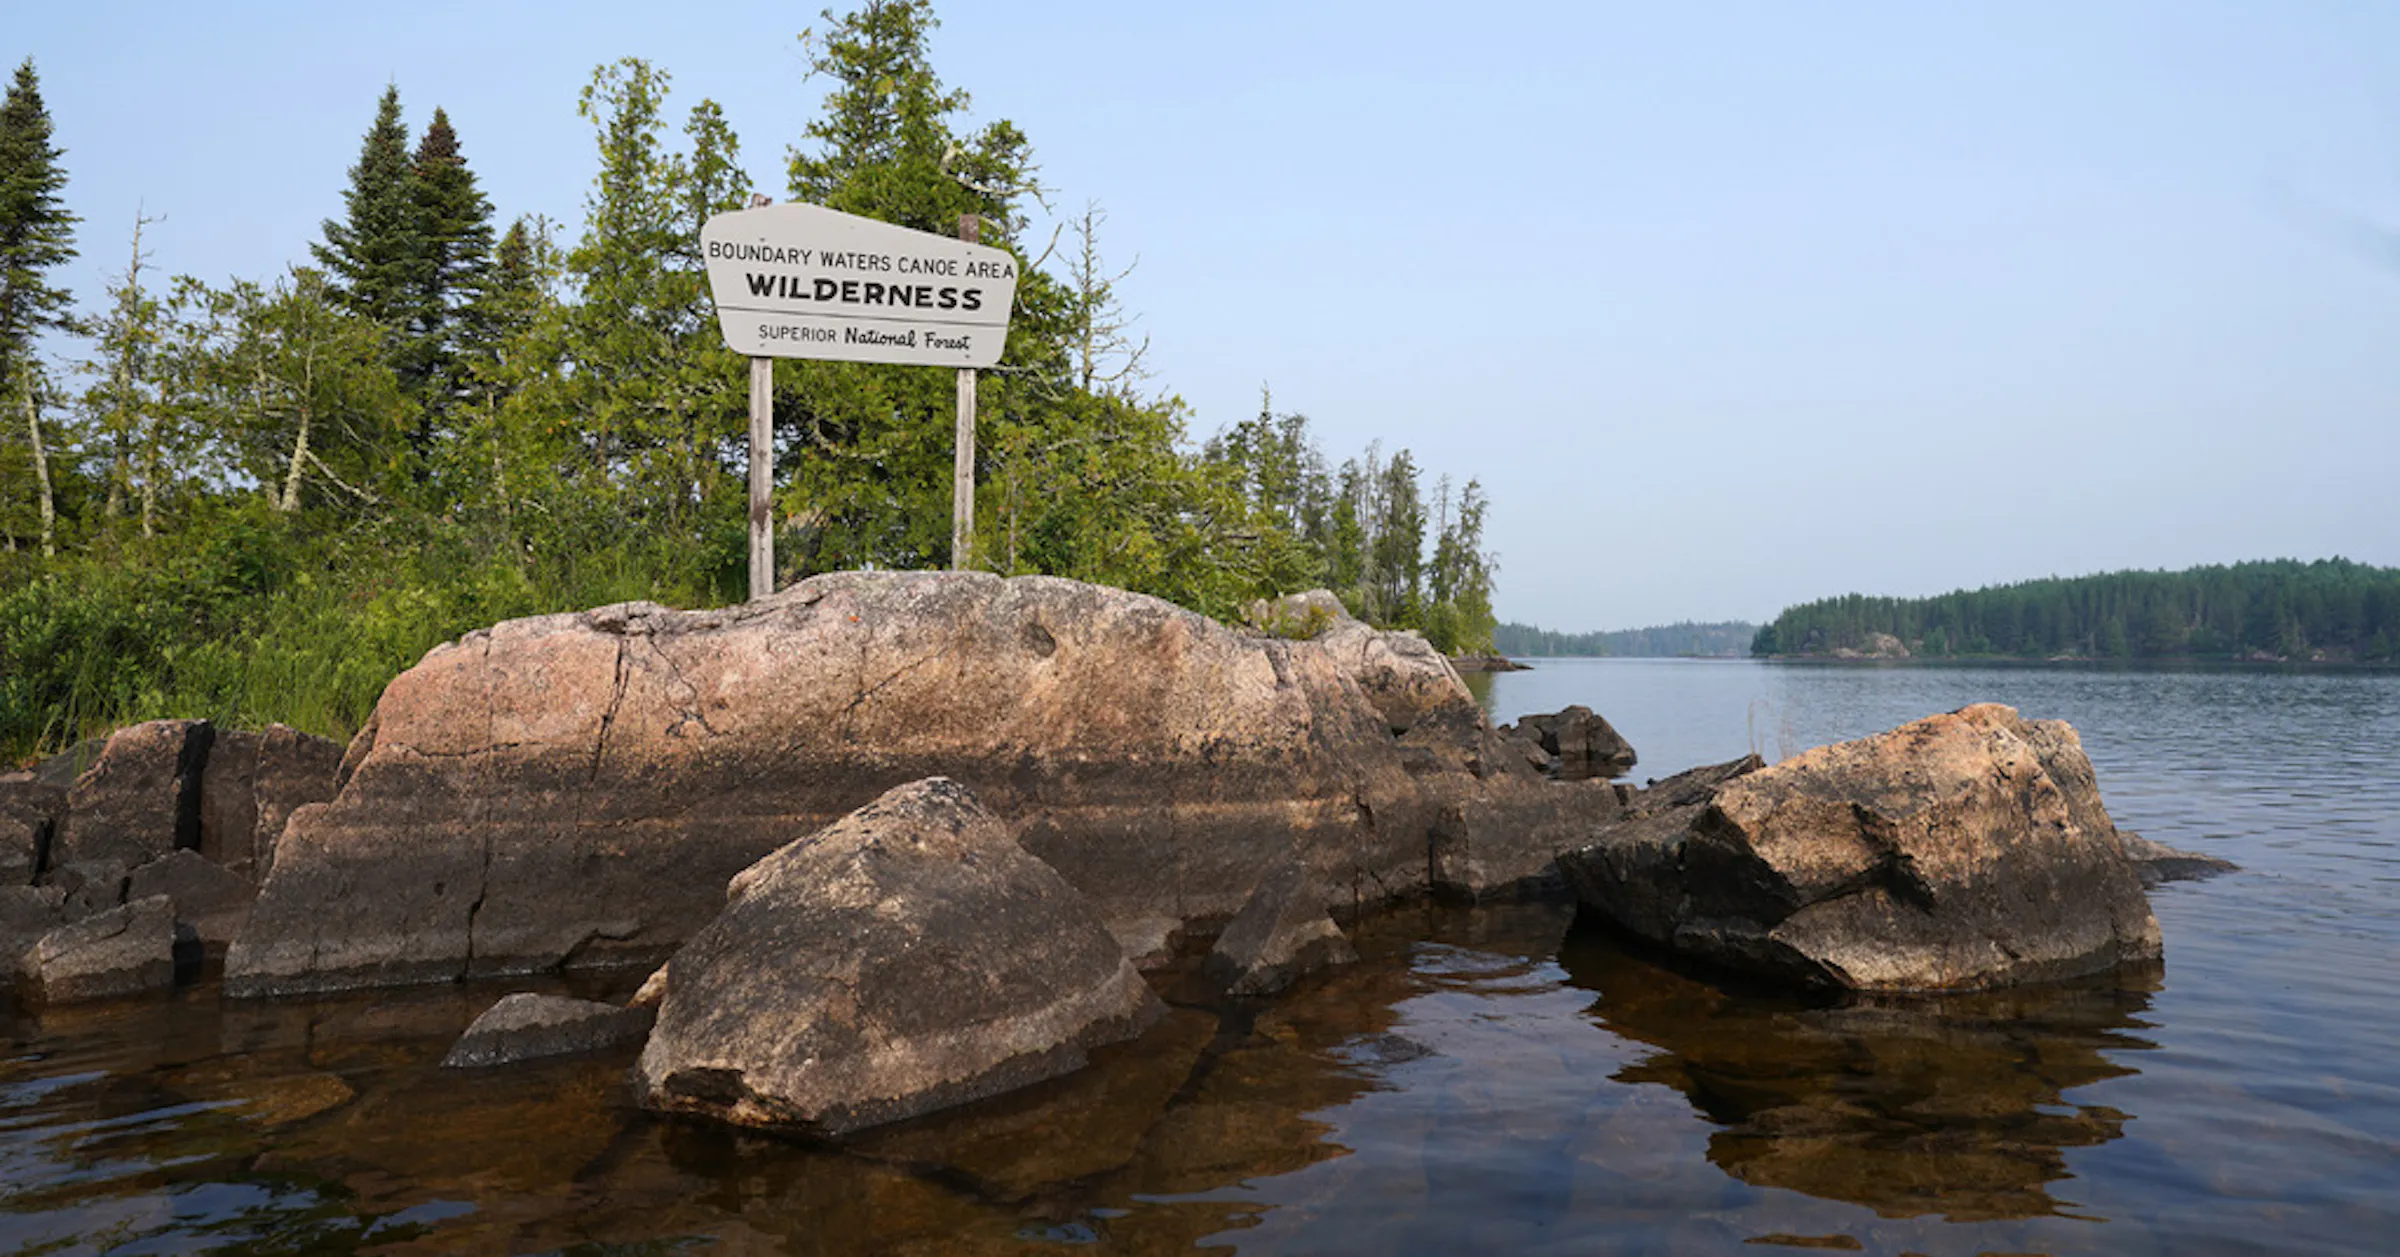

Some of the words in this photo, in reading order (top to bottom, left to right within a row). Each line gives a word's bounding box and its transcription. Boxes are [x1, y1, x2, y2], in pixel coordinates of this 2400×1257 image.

[709, 242, 812, 265] BOUNDARY
[820, 251, 891, 272] WATERS
[898, 257, 958, 277] CANOE
[965, 262, 1015, 279] AREA
[746, 273, 982, 311] WILDERNESS
[759, 324, 836, 343] SUPERIOR
[844, 327, 917, 348] National
[924, 332, 971, 350] Forest
